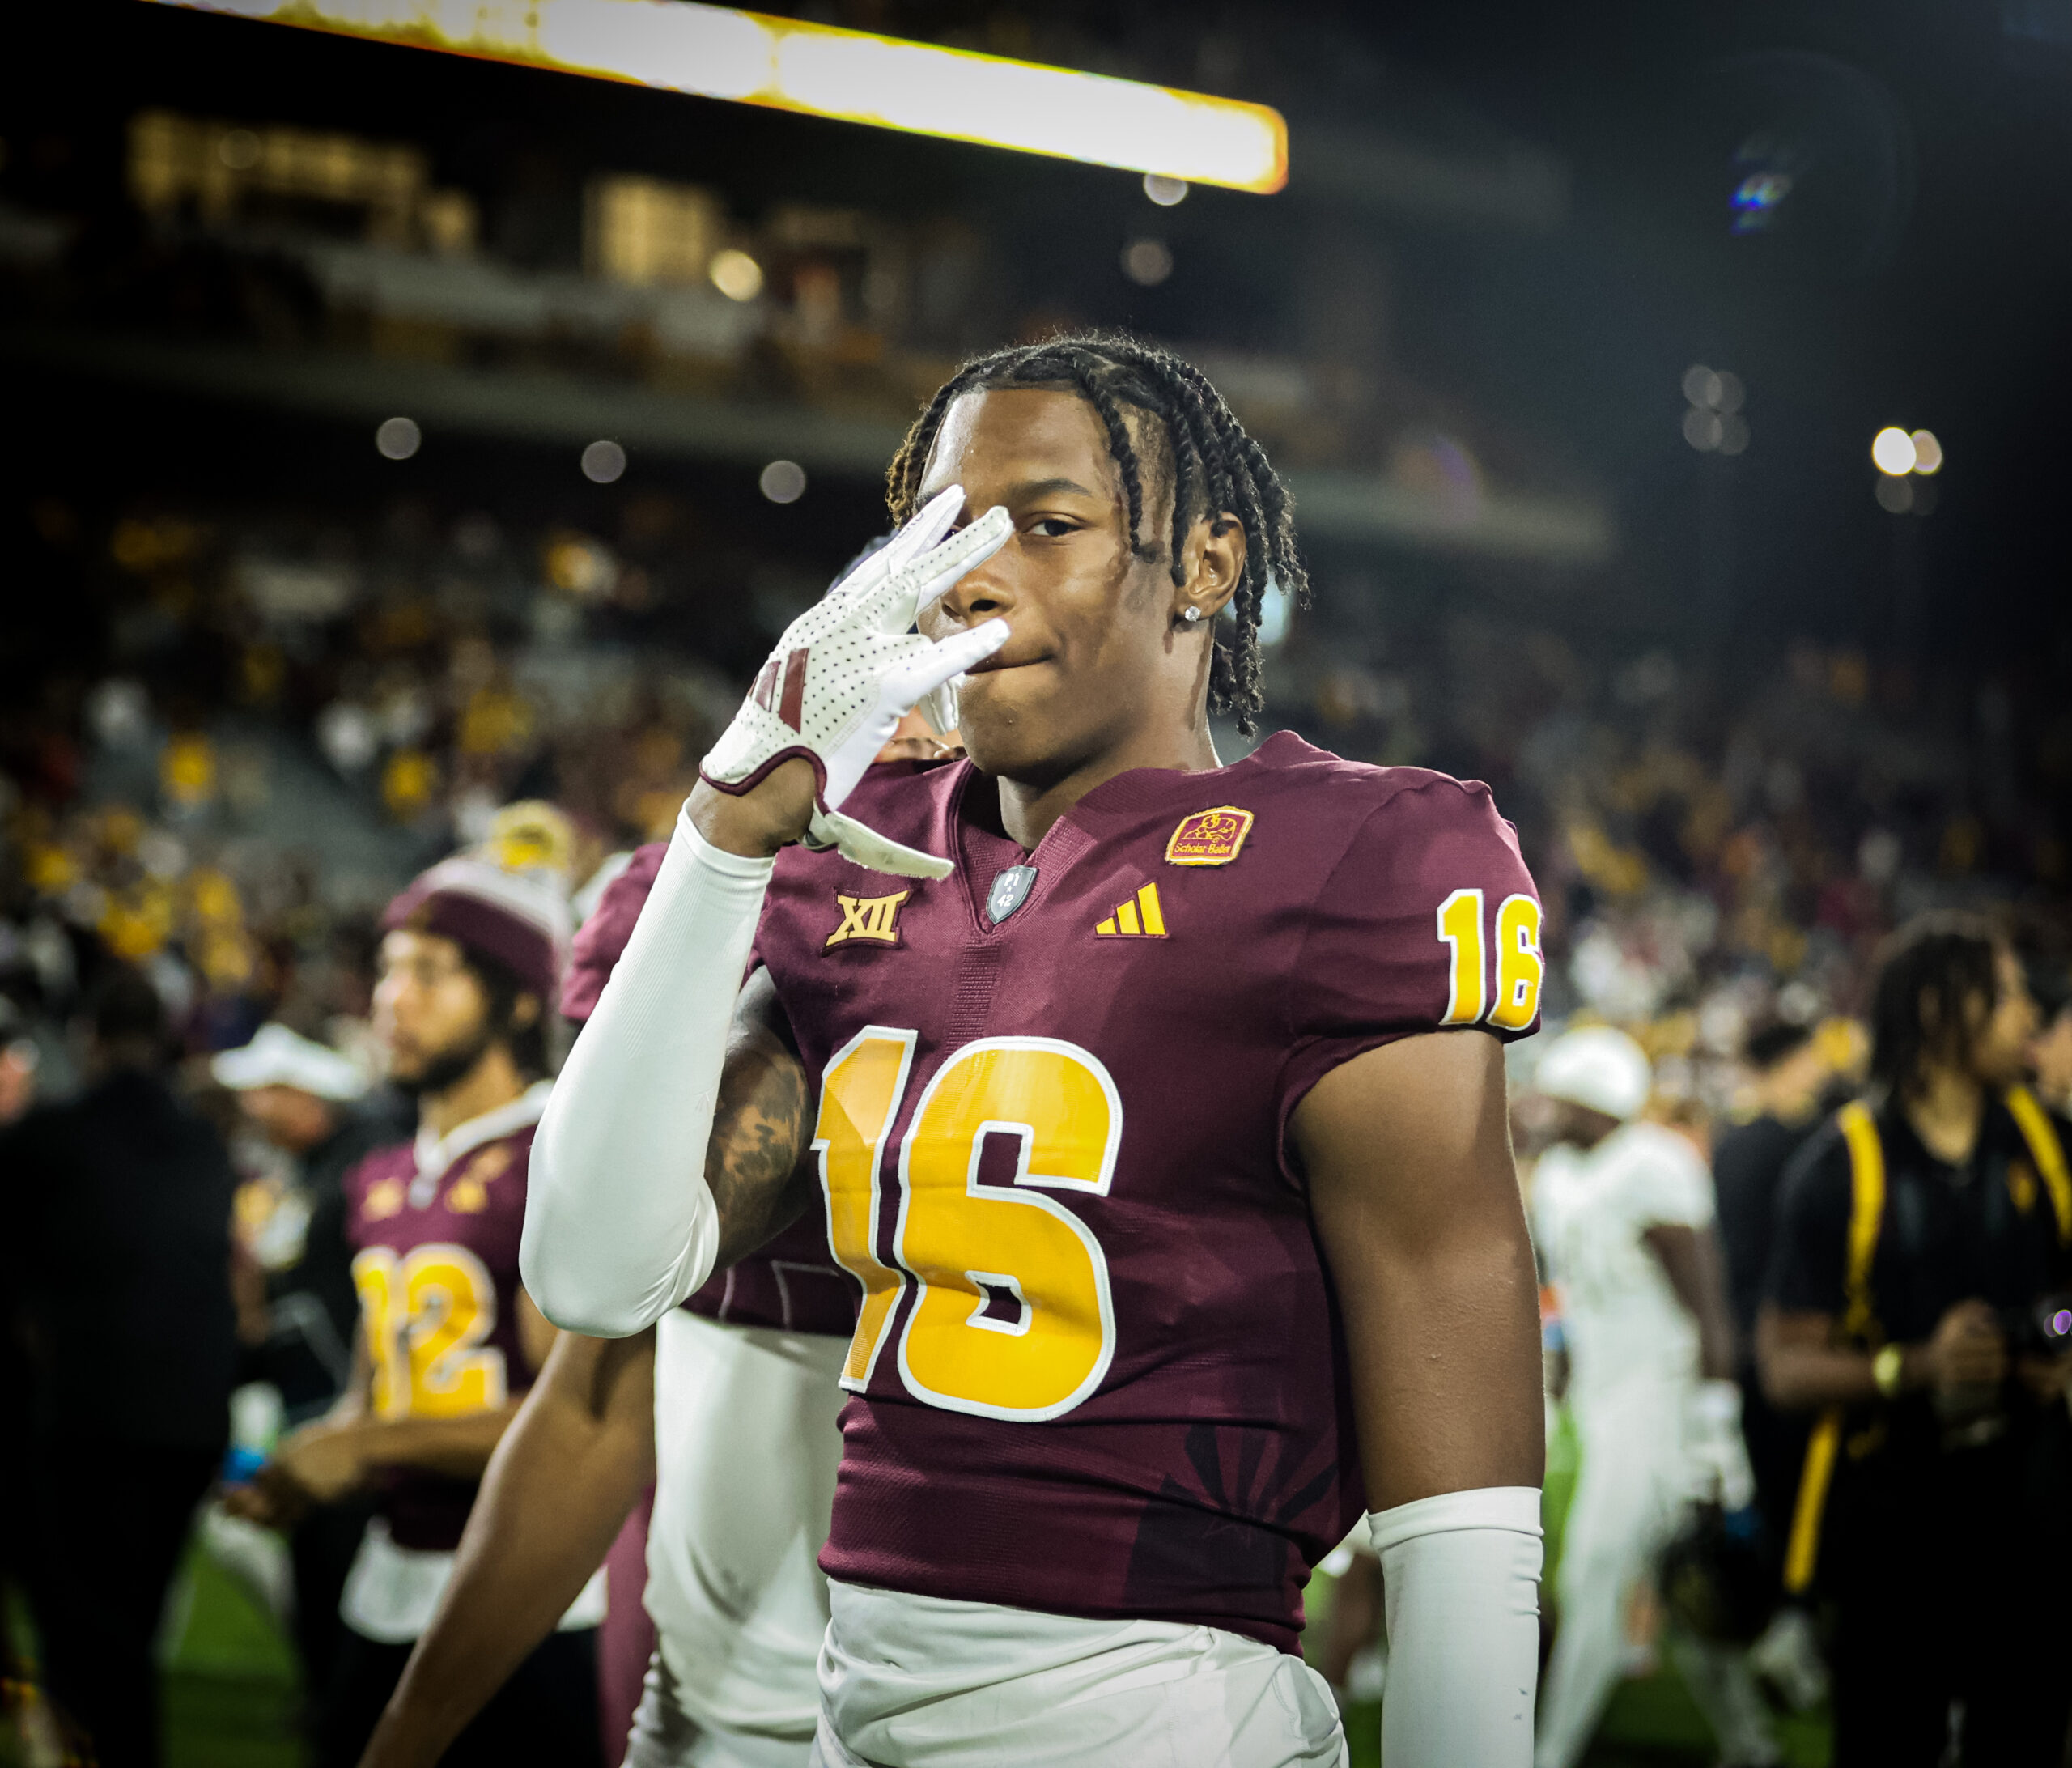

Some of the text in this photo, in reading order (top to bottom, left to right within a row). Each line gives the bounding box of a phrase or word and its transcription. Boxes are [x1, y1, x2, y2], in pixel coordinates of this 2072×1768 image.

[826, 890, 909, 946] XII
[996, 894, 1014, 907] 42
[1437, 888, 1543, 1031] 16
[810, 1025, 1123, 1422] 16
[350, 1242, 508, 1421] 12
